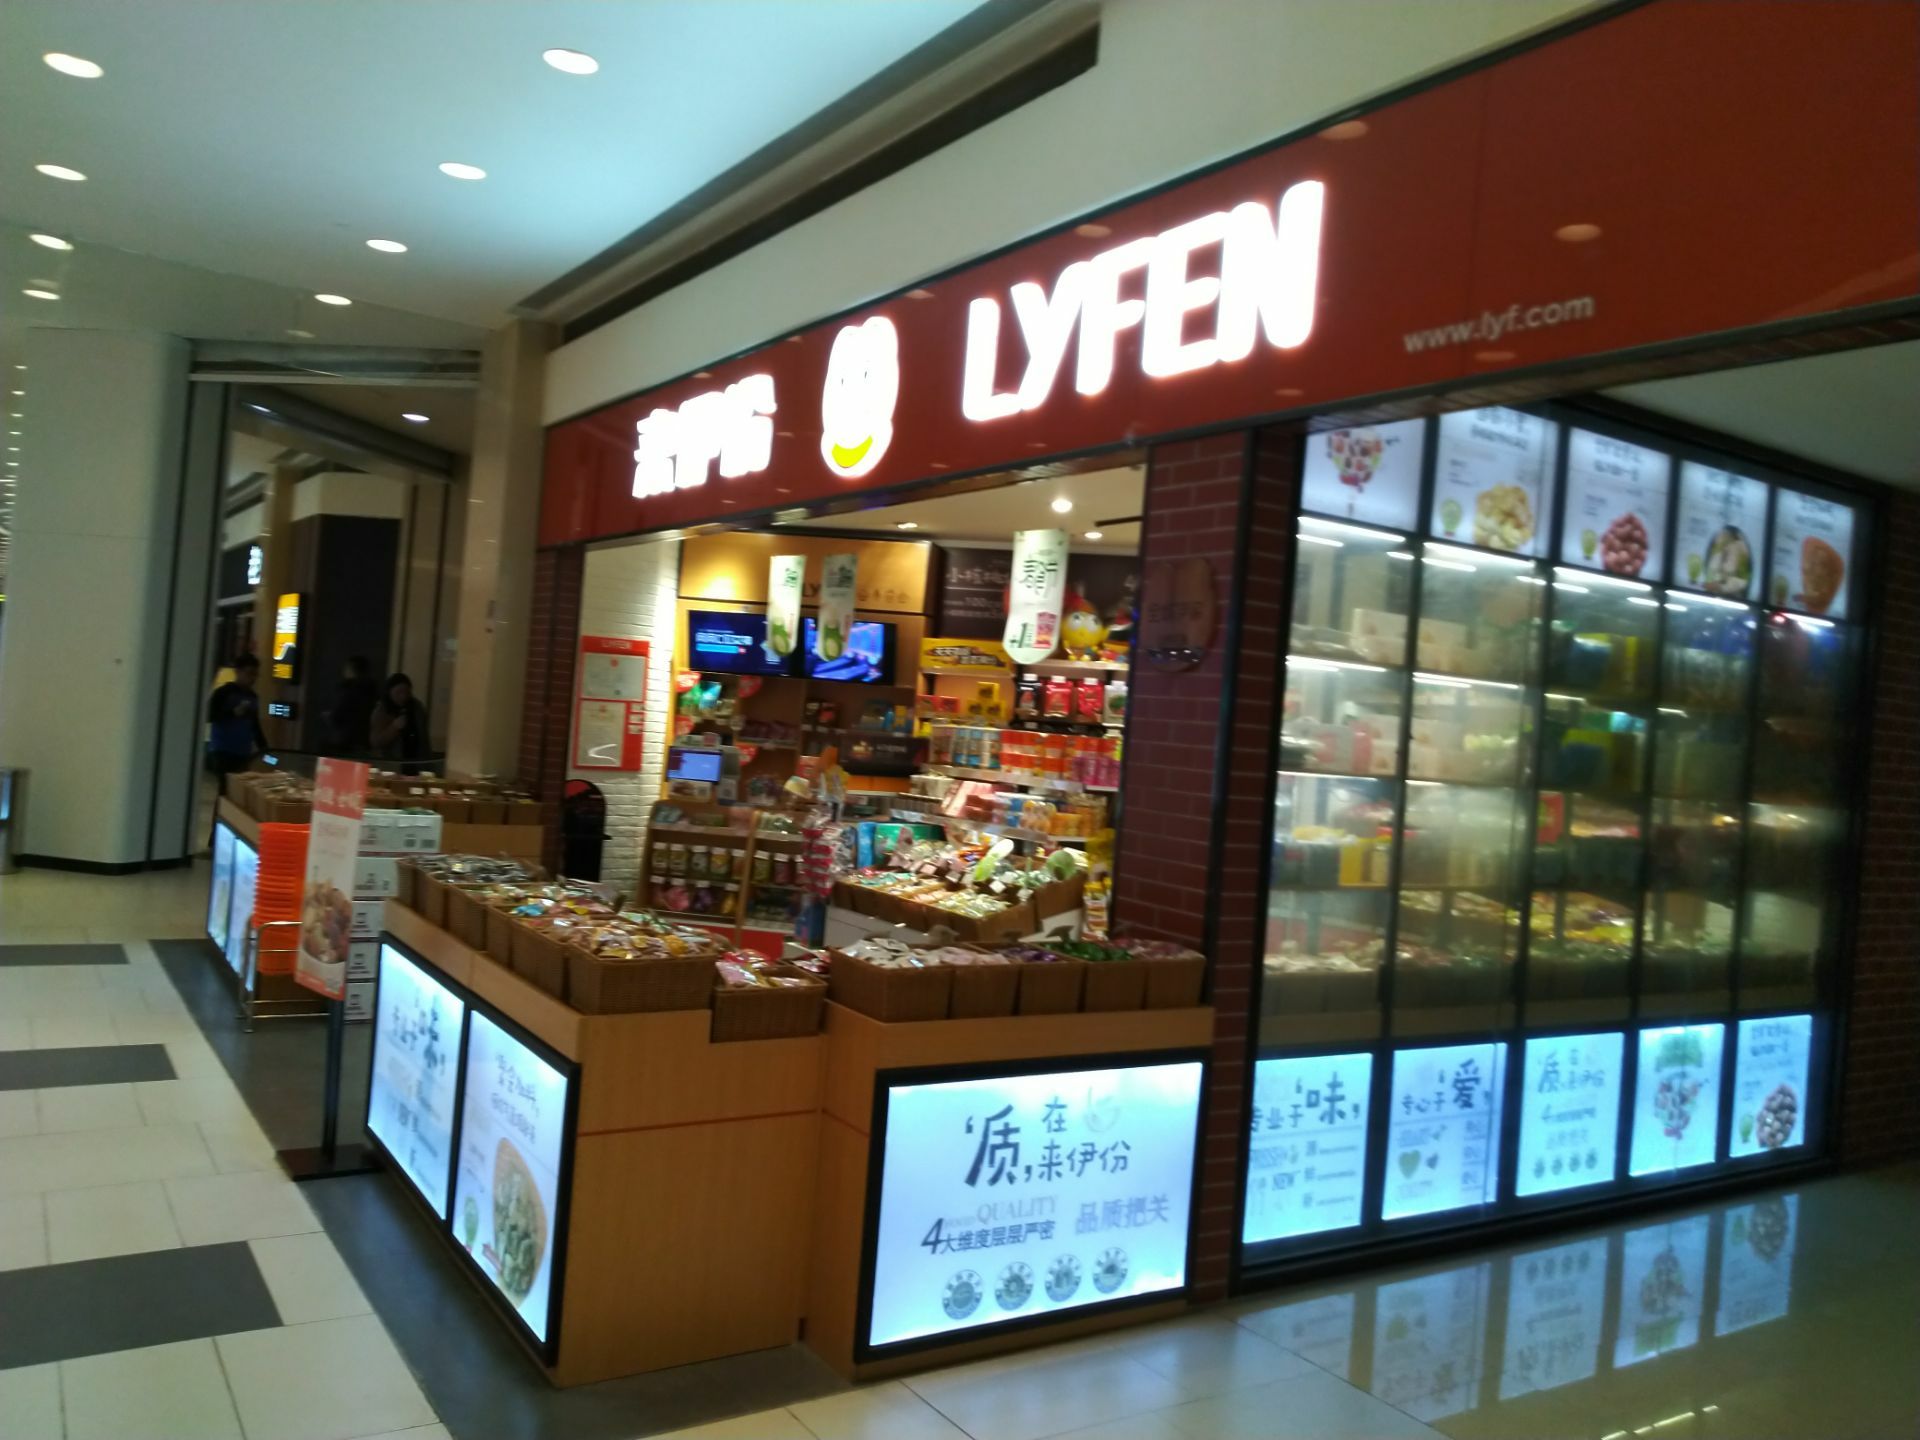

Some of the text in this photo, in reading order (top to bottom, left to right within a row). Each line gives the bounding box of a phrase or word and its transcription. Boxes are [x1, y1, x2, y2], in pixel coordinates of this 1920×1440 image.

[961, 180, 1325, 422] LYFEN
[1402, 296, 1595, 353] www.lyf.com
[1038, 1138, 1132, 1182] 来伊份
[977, 1195, 1058, 1222] QUALITY
[1075, 1194, 1170, 1236] 品质把关
[920, 1217, 1056, 1255] 4大维度层层严密
